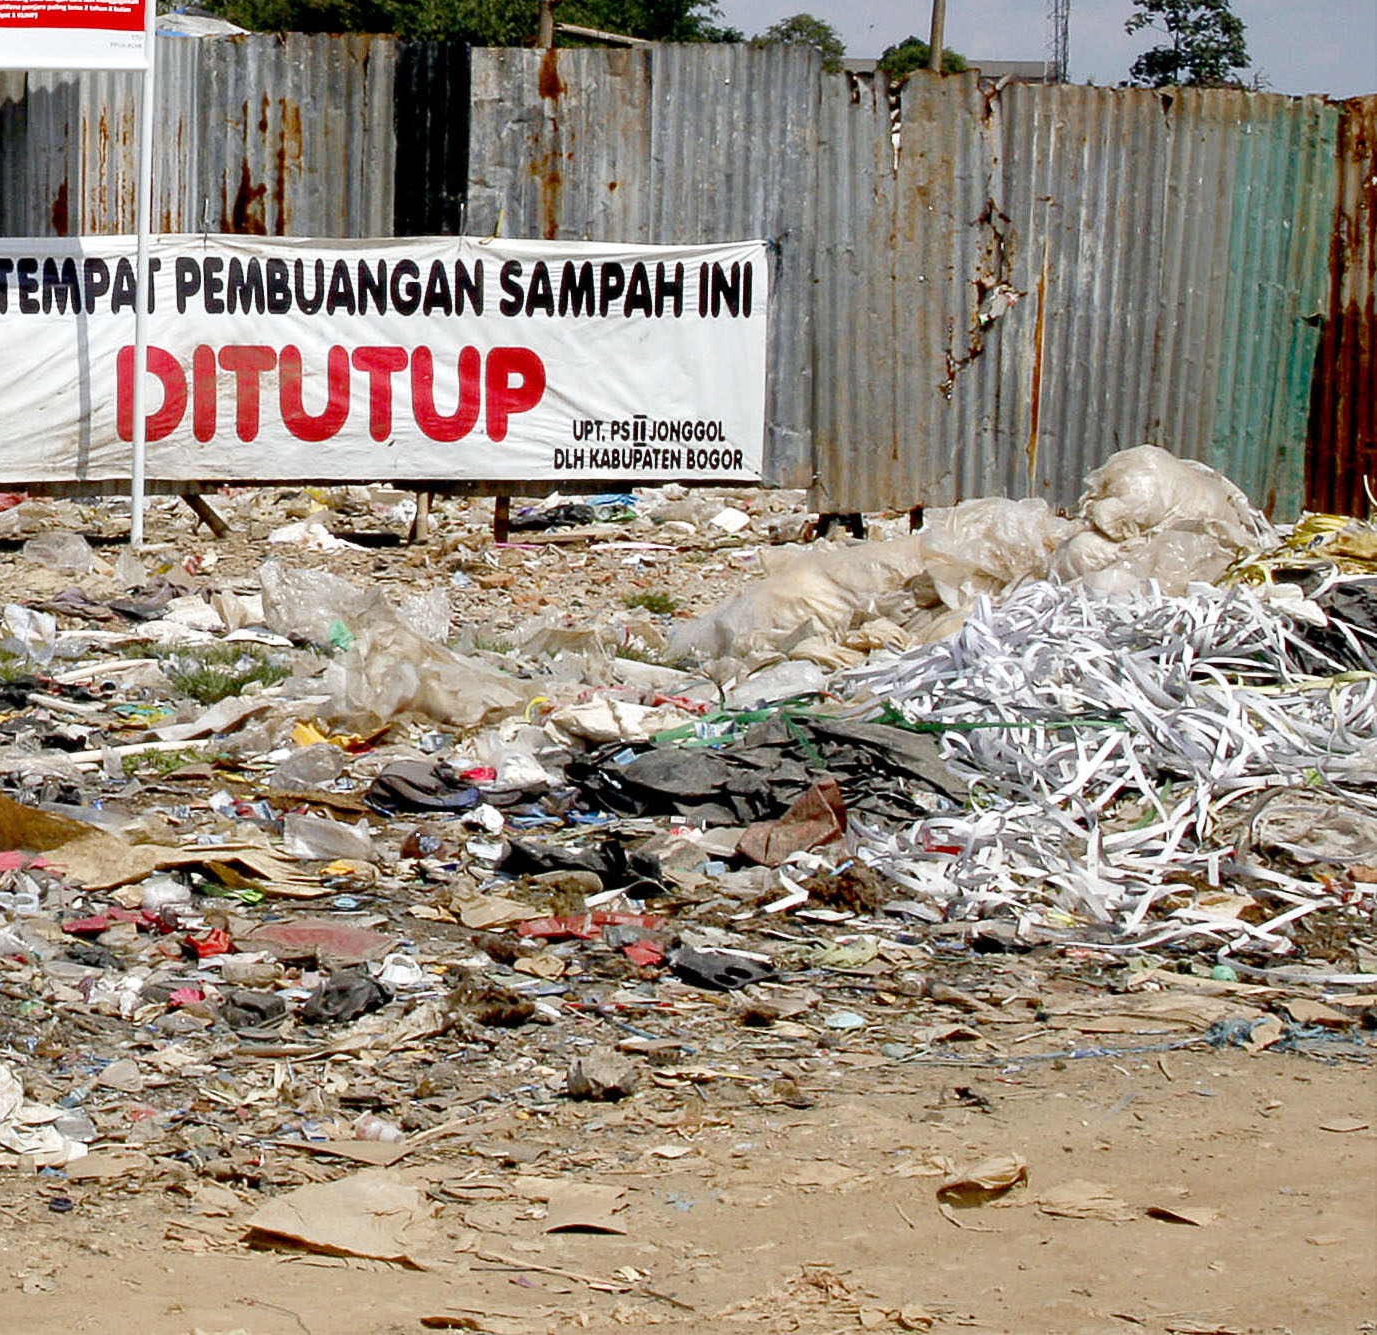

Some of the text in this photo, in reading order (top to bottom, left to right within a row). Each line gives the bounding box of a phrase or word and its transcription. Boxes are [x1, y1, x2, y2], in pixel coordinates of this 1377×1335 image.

[176, 257, 485, 318] PEMBUANGAN
[500, 260, 686, 319] SAMPAH
[699, 262, 754, 319] INI
[117, 345, 547, 444] DITUTUP
[574, 421, 607, 442] UPT.
[650, 421, 727, 443] JONGGOL
[555, 449, 744, 471] DLH KABUPATEN BOGOR
